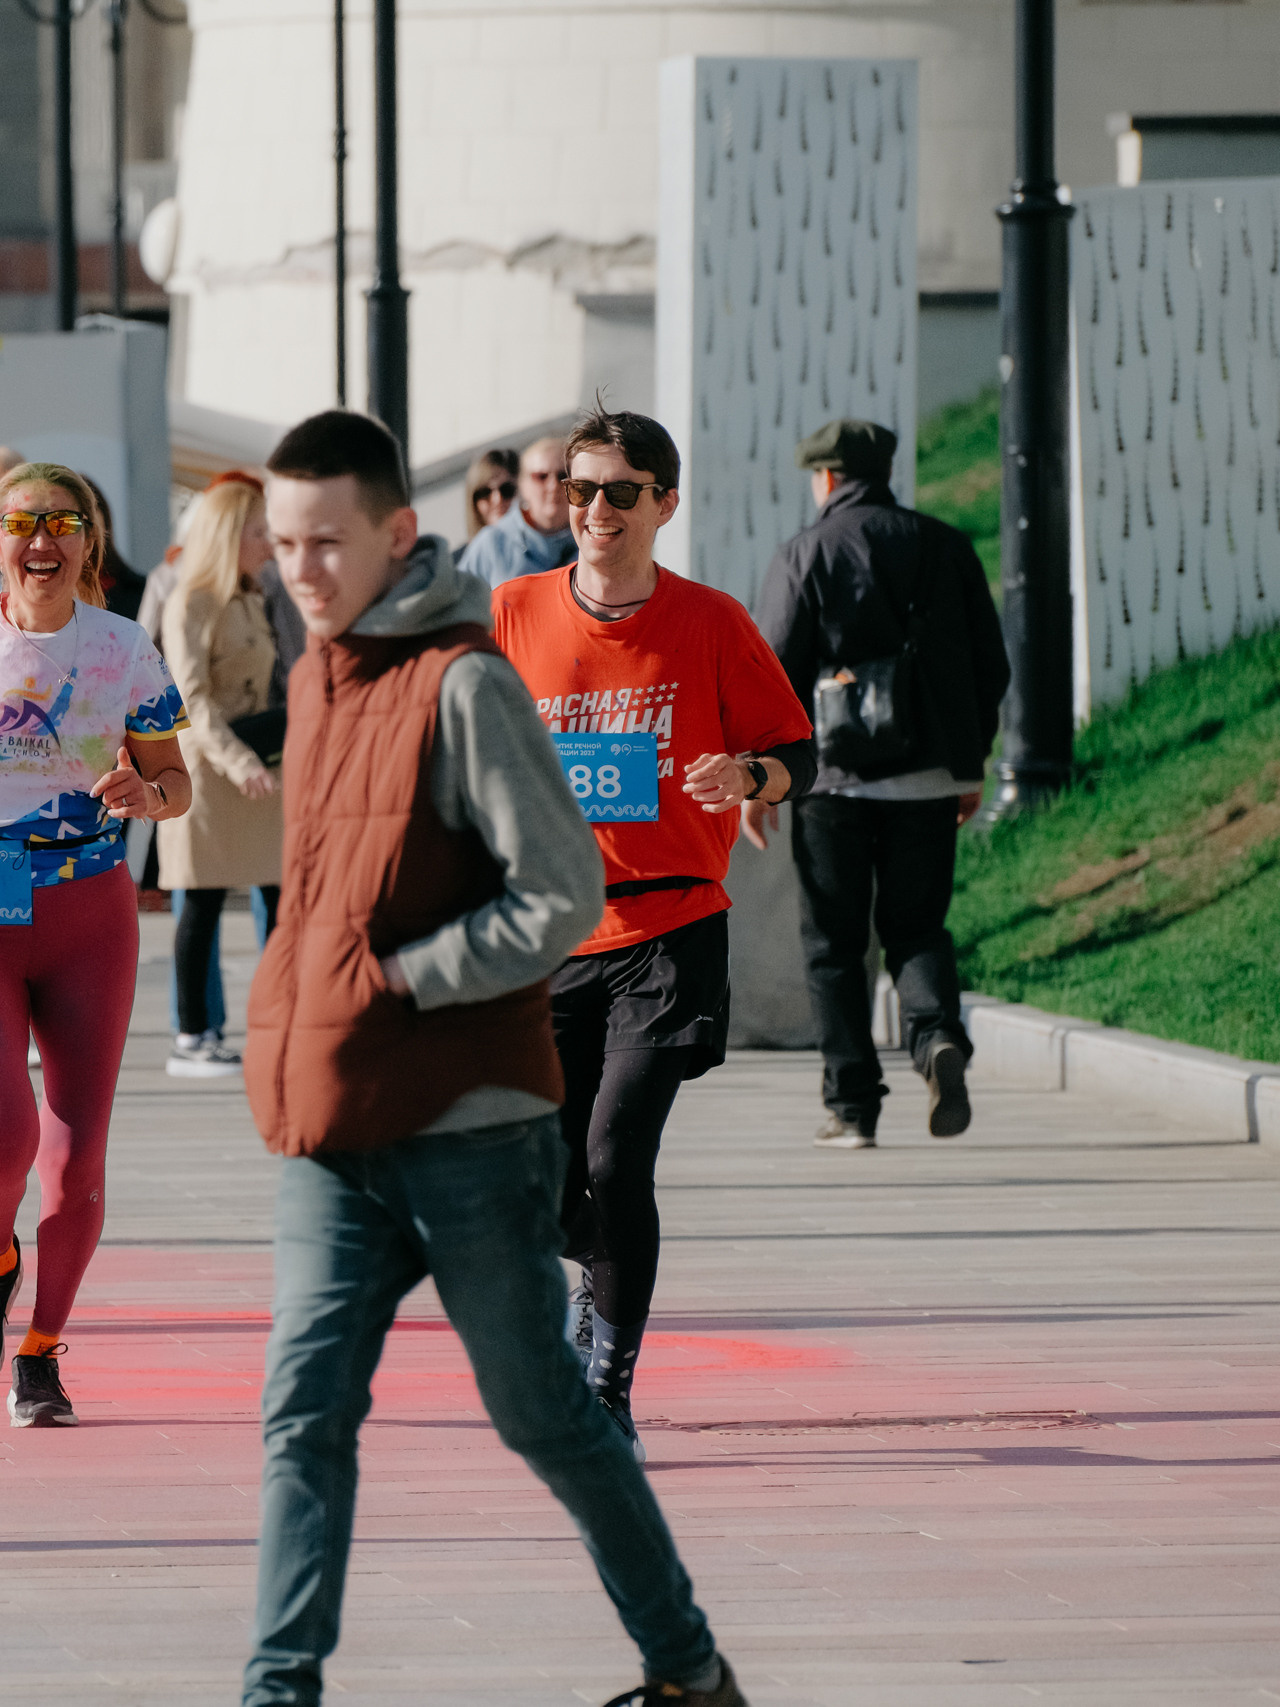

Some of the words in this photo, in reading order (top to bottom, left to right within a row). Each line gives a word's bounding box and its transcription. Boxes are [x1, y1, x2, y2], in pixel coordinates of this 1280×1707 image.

[535, 687, 633, 720] РАСНАЯ
[8, 735, 51, 750] BAIKAL
[574, 742, 602, 750] РЕЧНОЙ
[568, 763, 622, 799] 88
